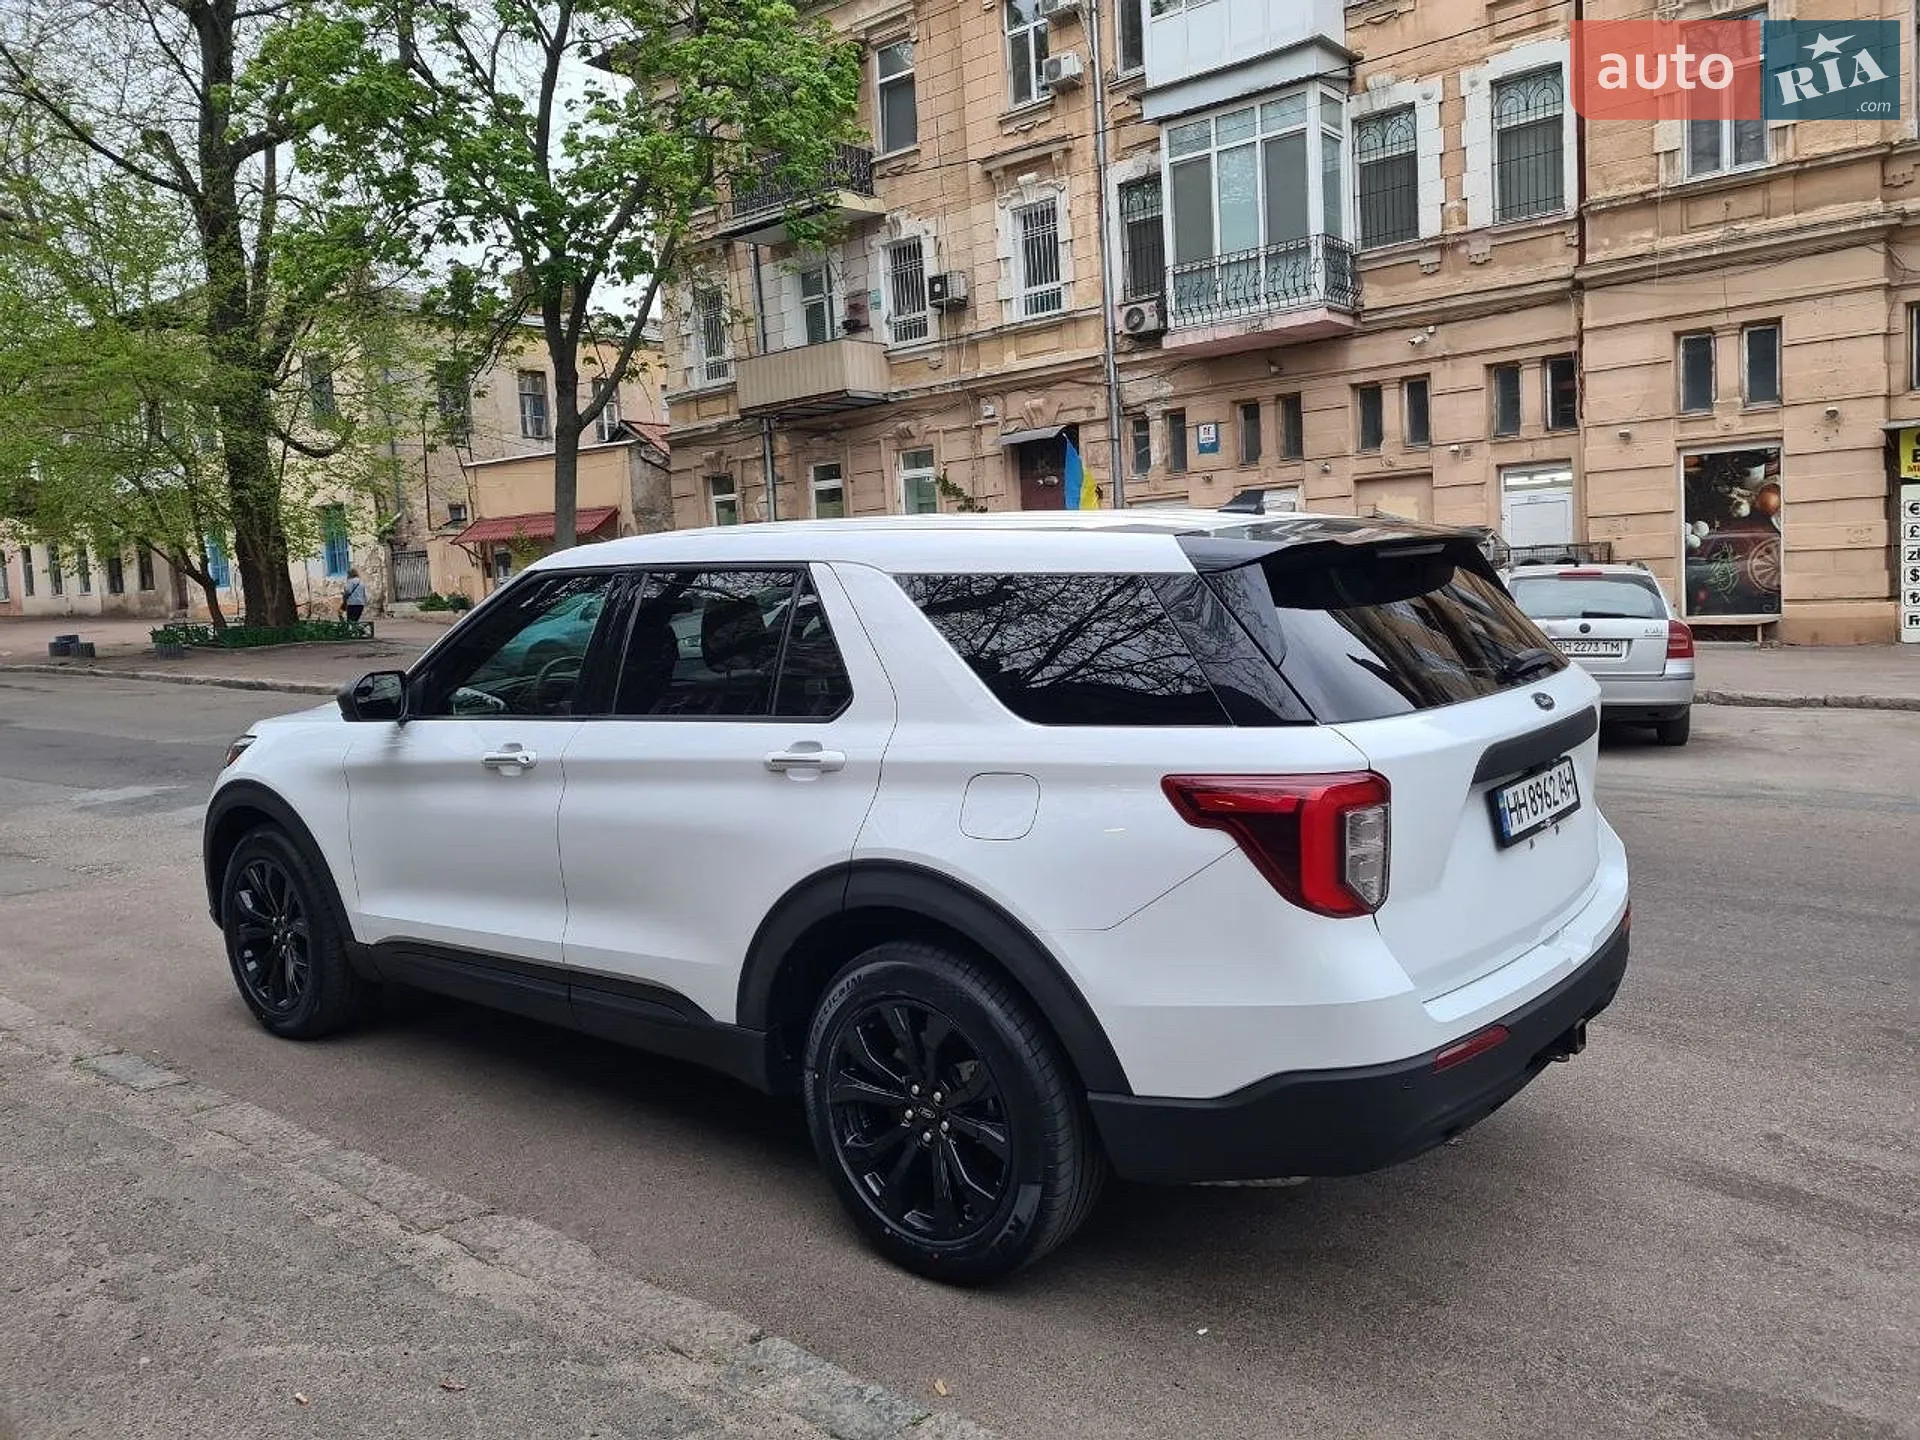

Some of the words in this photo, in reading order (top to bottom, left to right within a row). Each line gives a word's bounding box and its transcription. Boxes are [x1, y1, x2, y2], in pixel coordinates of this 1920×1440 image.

[1909, 568, 1920, 583] $
[1573, 641, 1600, 652] 2273
[1602, 641, 1620, 652] TM
[1528, 776, 1559, 816] 8962
